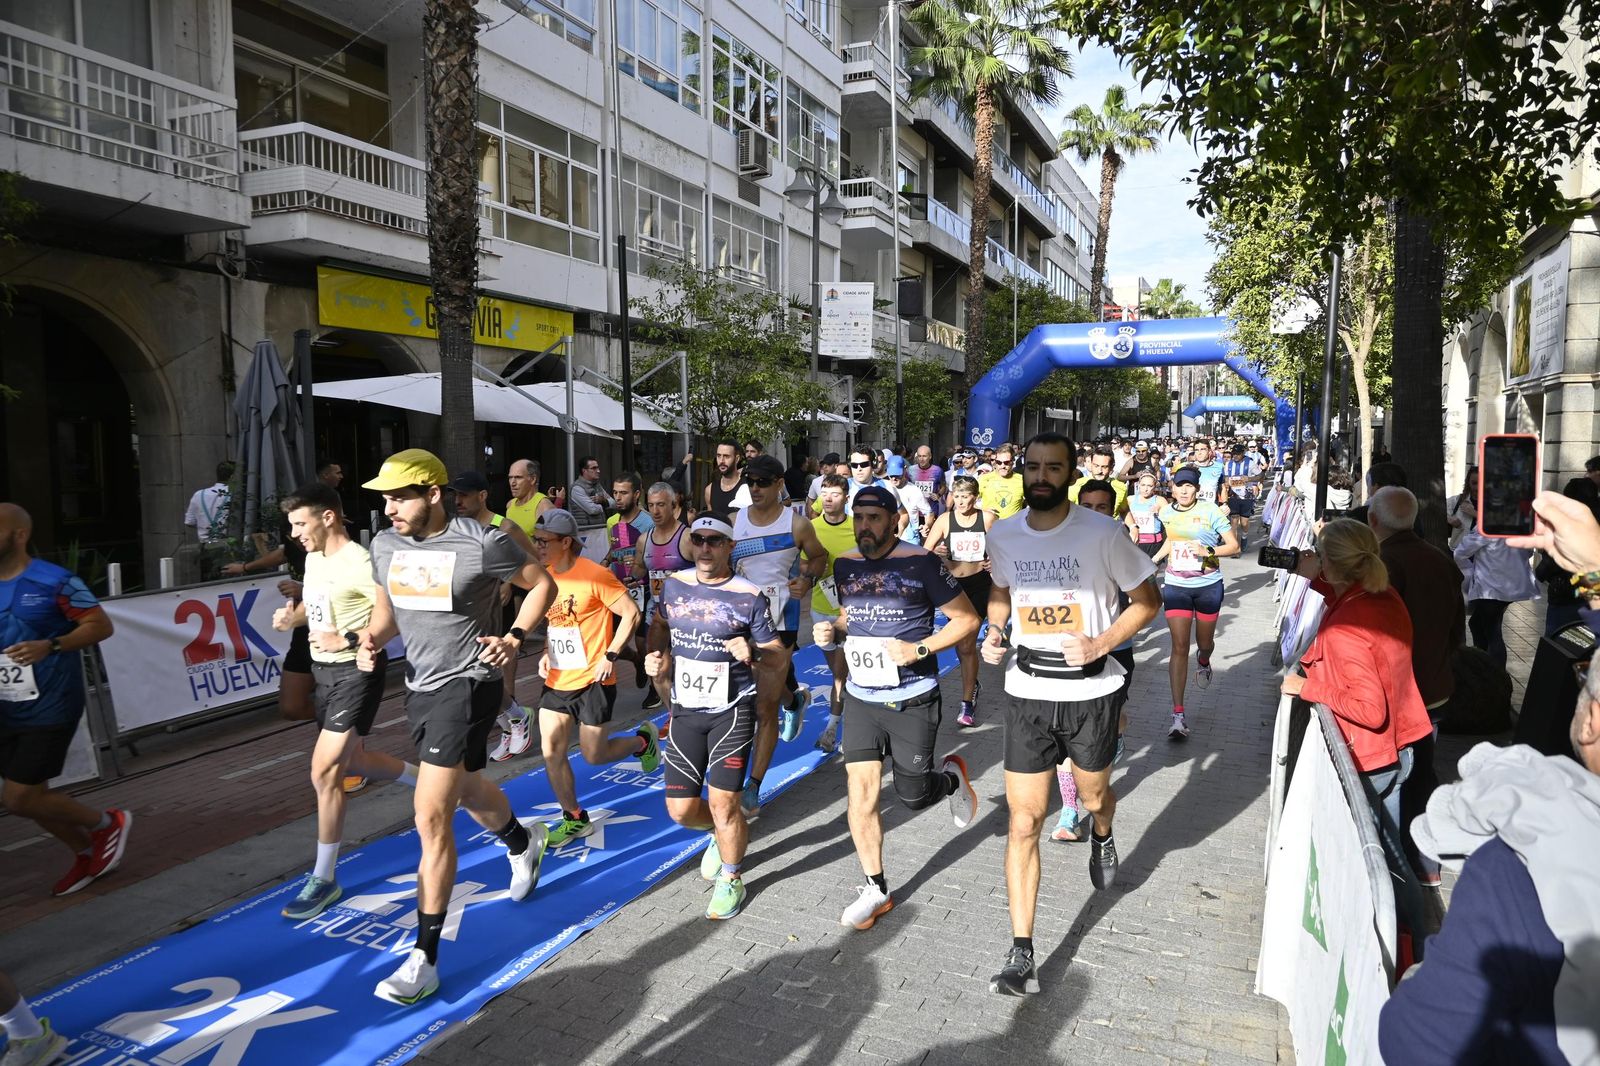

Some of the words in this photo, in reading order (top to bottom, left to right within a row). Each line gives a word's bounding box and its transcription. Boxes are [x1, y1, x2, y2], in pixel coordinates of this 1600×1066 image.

[1139, 340, 1182, 348] PROVINCIAL
[957, 540, 980, 551] 879
[1175, 548, 1200, 559] 74
[1014, 560, 1046, 571] VOLTA
[1049, 560, 1056, 569] A
[1059, 555, 1080, 571] RÍA
[1028, 606, 1073, 626] 482
[551, 639, 575, 654] 706
[187, 662, 215, 675] CIUDAD
[218, 660, 228, 668] DE
[852, 651, 885, 669] 961
[189, 658, 282, 701] HUELVA
[682, 672, 718, 693] 947
[292, 911, 419, 956] HUELV
